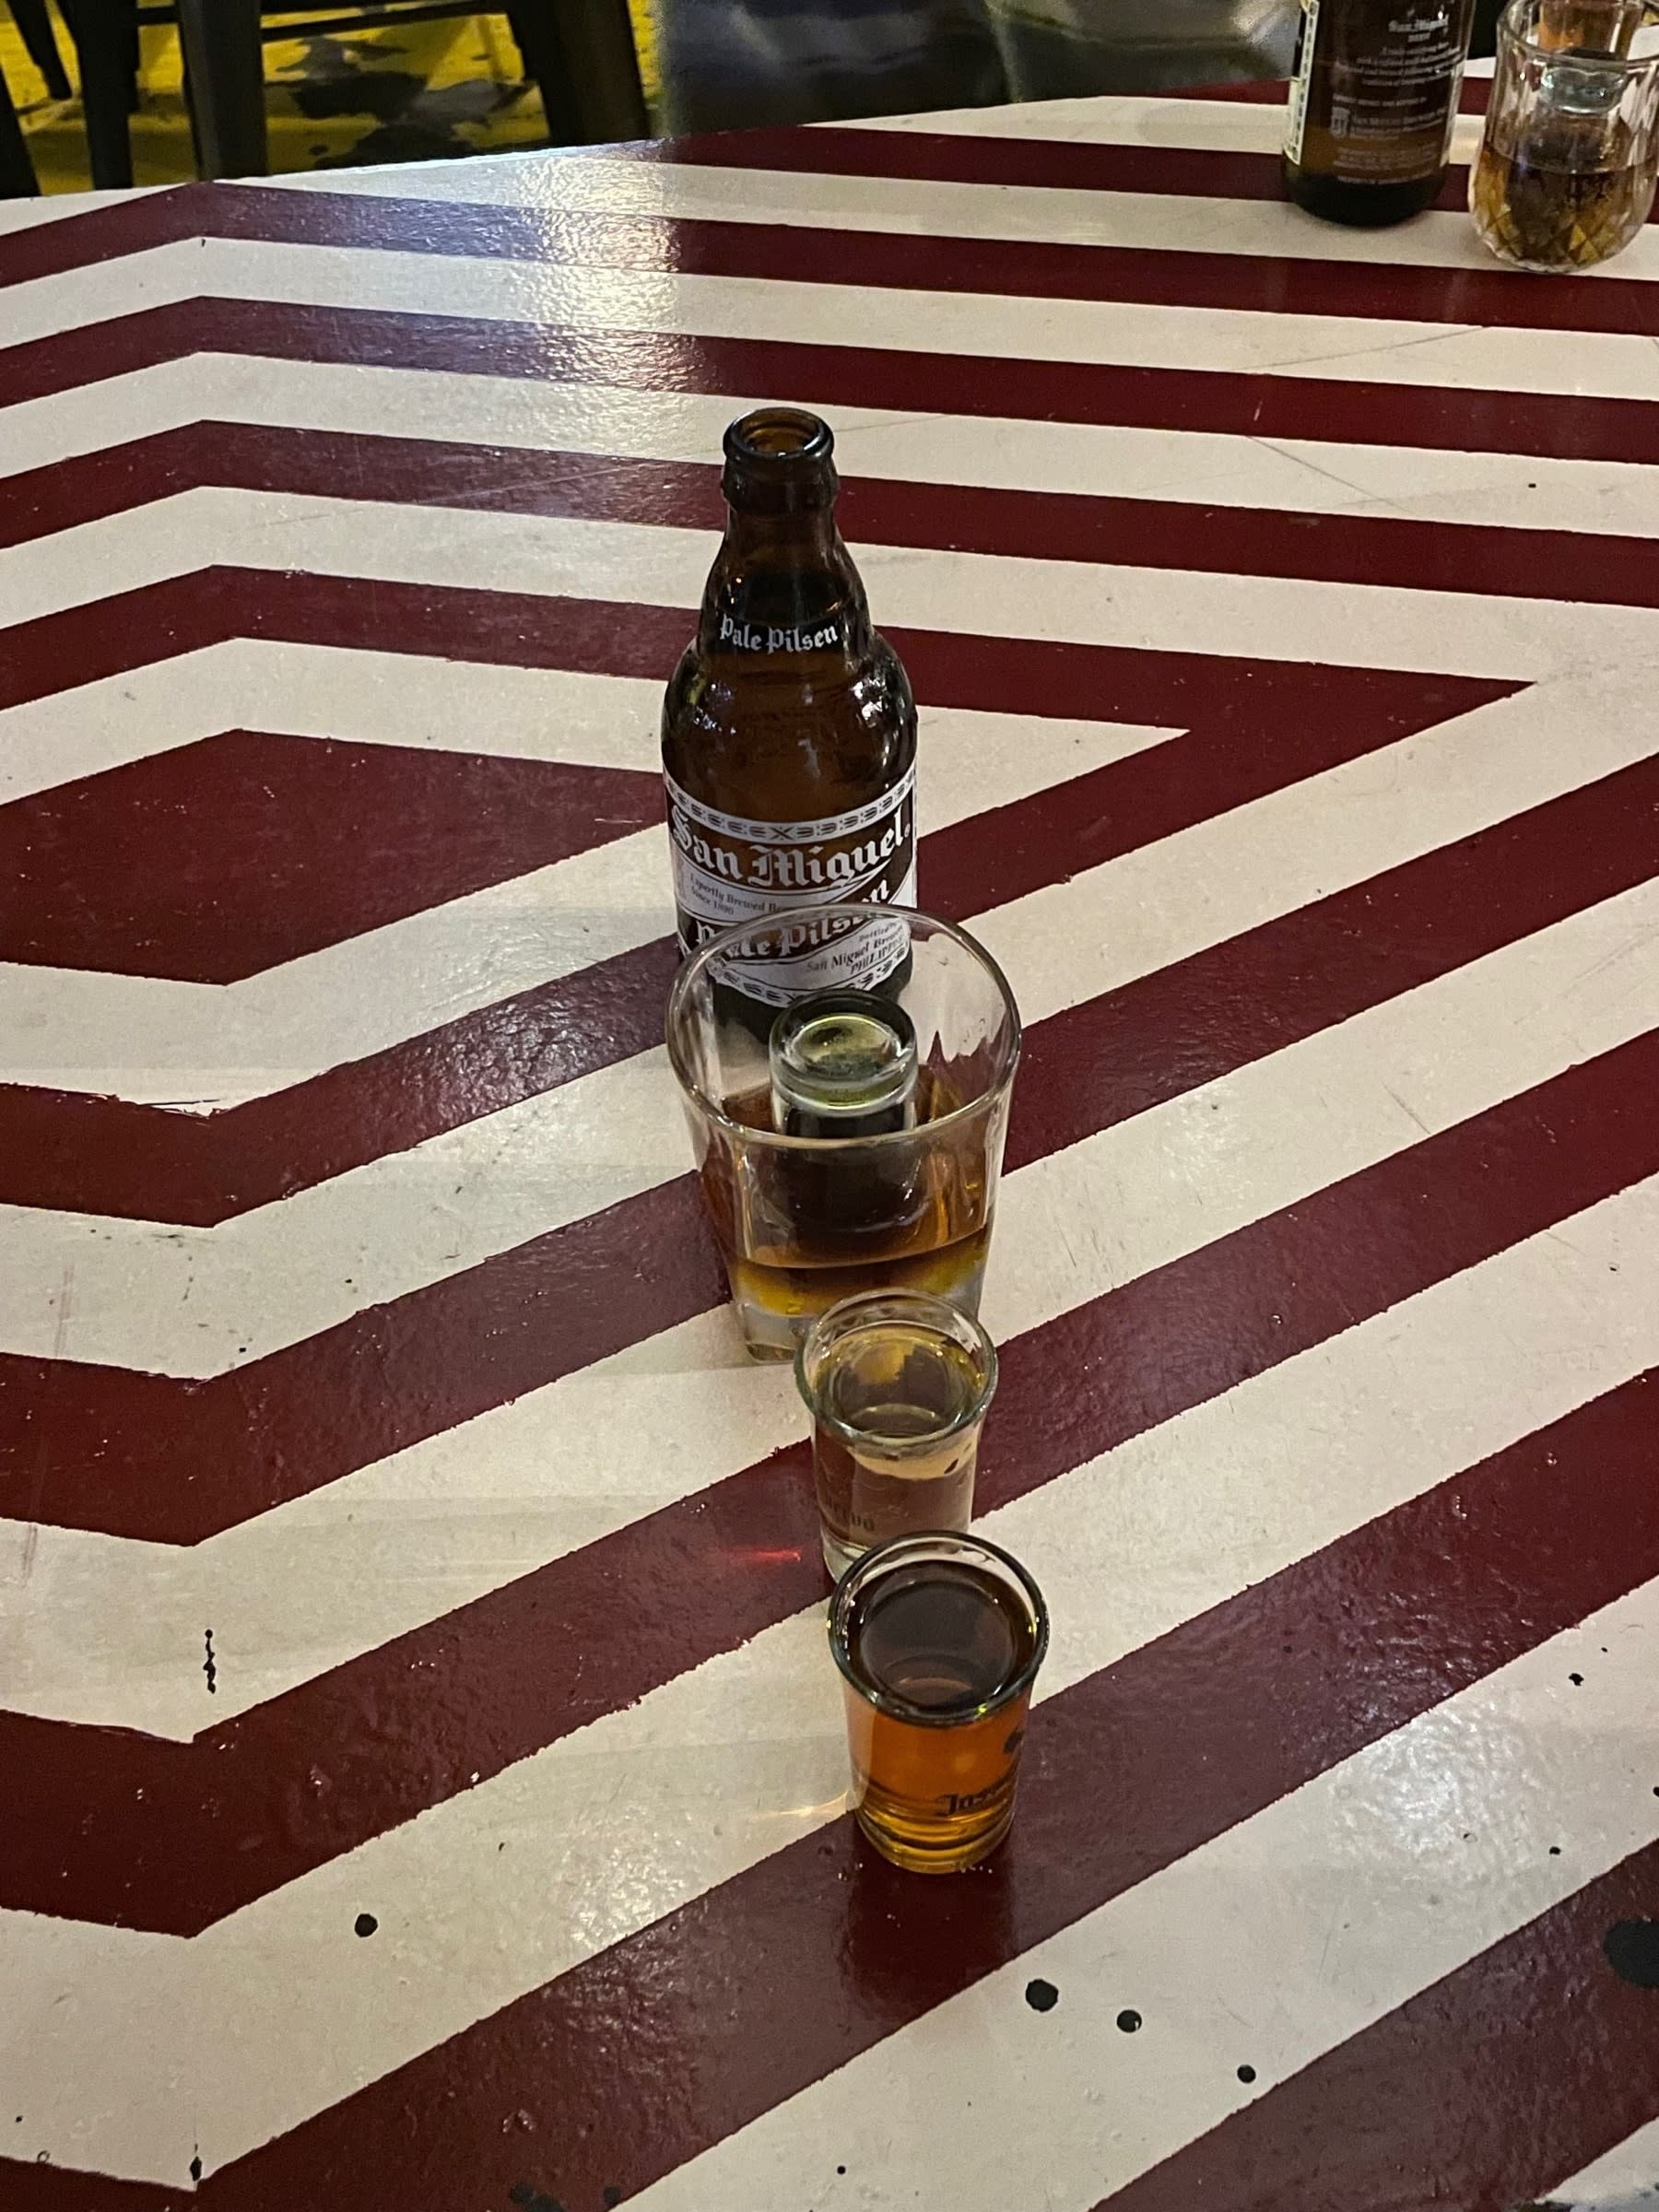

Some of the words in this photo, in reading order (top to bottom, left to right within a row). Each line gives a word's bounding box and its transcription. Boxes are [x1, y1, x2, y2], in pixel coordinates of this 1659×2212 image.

[719, 612, 761, 651] Pale
[763, 625, 839, 655] Pilsen
[671, 805, 743, 879] San
[747, 806, 904, 888] Miguel
[726, 894, 766, 912] Brewed
[830, 941, 870, 968] Miguel
